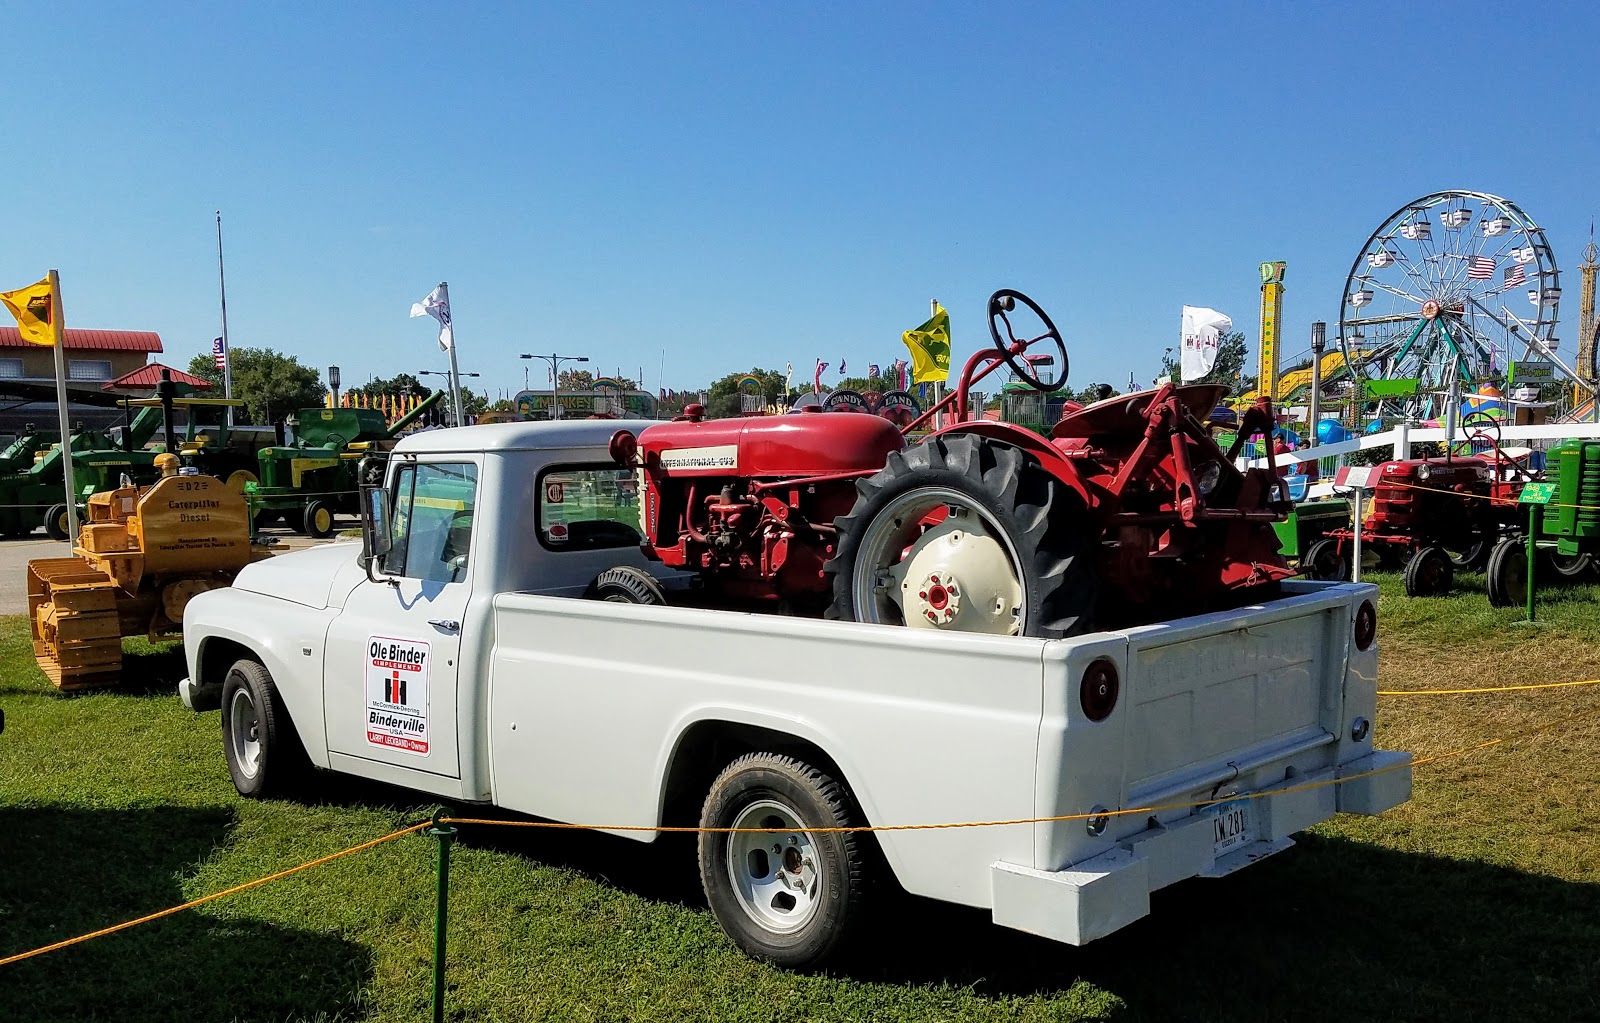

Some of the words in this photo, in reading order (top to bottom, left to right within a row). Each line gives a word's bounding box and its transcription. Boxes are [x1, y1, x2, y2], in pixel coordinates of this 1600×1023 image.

[830, 394, 862, 406] CANDY
[885, 394, 913, 406] LAND
[168, 500, 220, 509] Caterpillar
[180, 513, 210, 522] Diesel
[370, 641, 387, 659] Ole
[389, 644, 426, 664] Binder
[377, 660, 417, 670] IMPLEMENT
[372, 700, 420, 715] McCormick-Deering
[369, 711, 425, 733] Binderville
[369, 732, 385, 743] LARRY
[389, 728, 404, 736] USA
